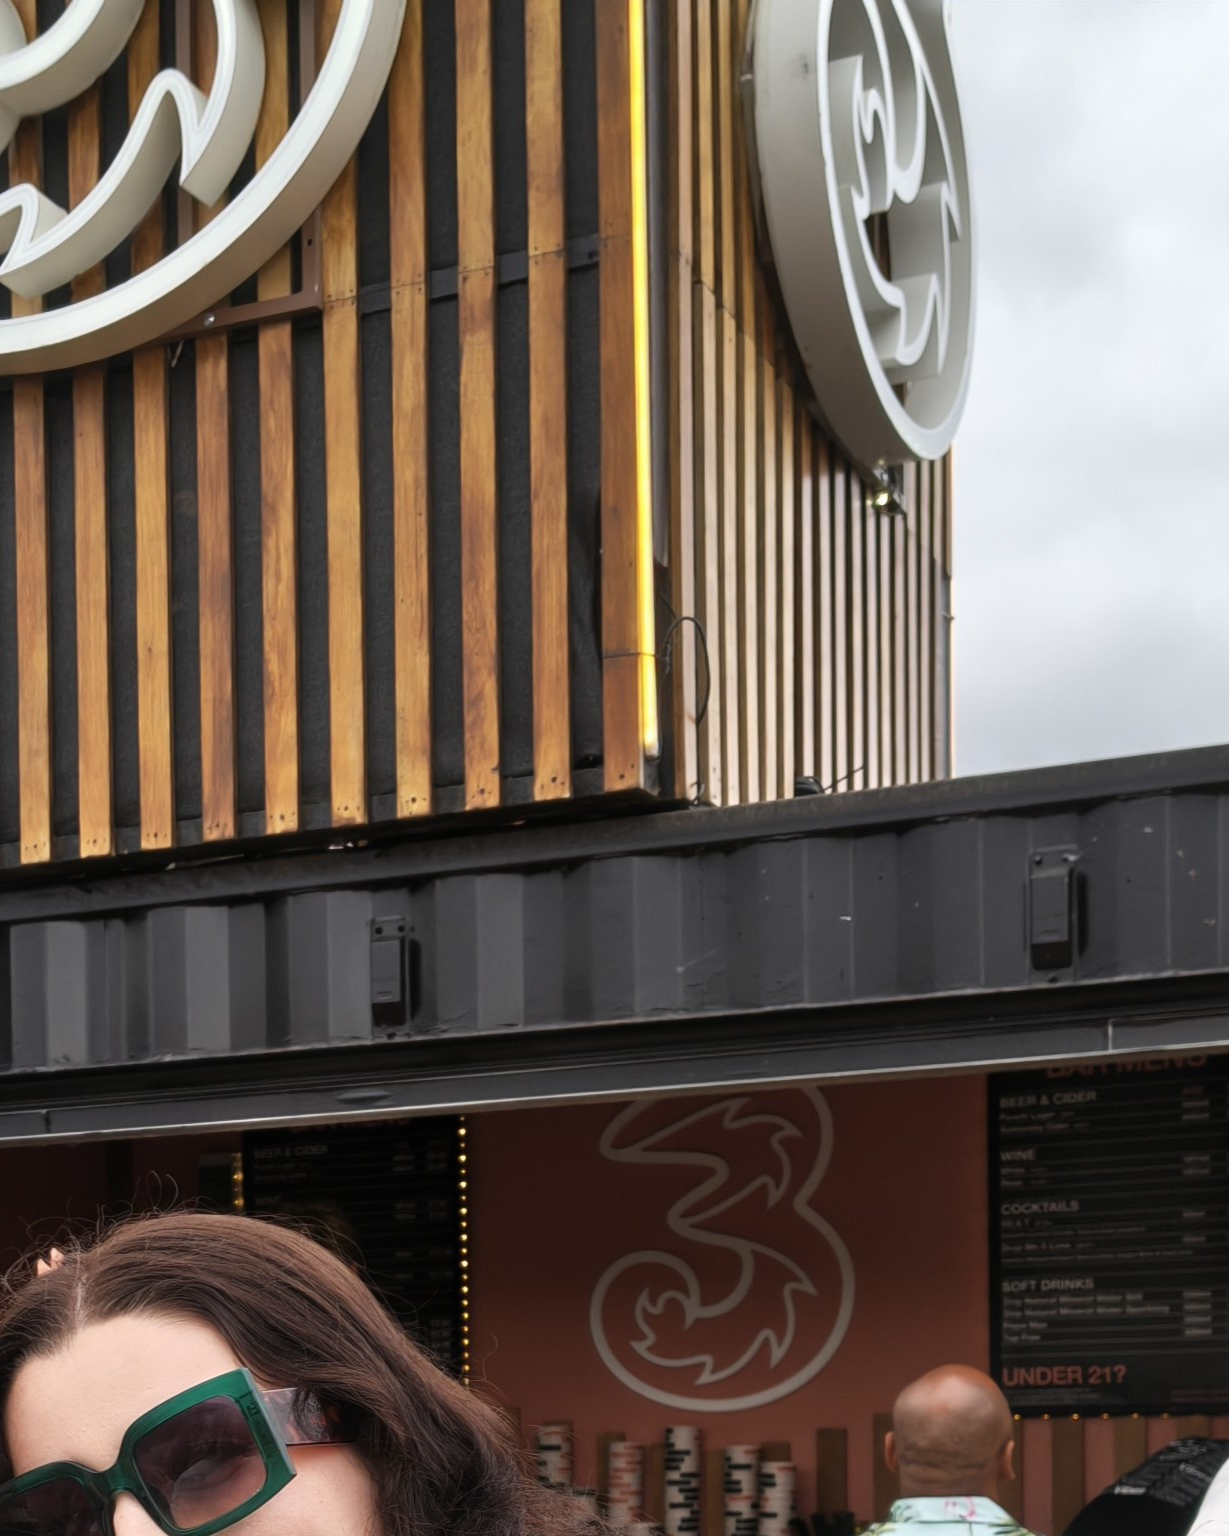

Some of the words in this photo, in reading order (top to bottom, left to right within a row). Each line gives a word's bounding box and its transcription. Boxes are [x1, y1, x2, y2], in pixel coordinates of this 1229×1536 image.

[1001, 1200, 1079, 1215] COCKTAILS
[1002, 1279, 1037, 1293] SOFT
[1041, 1278, 1094, 1292] DRINKS
[1002, 1366, 1083, 1387] UNDER
[1088, 1364, 1127, 1385] 21?
